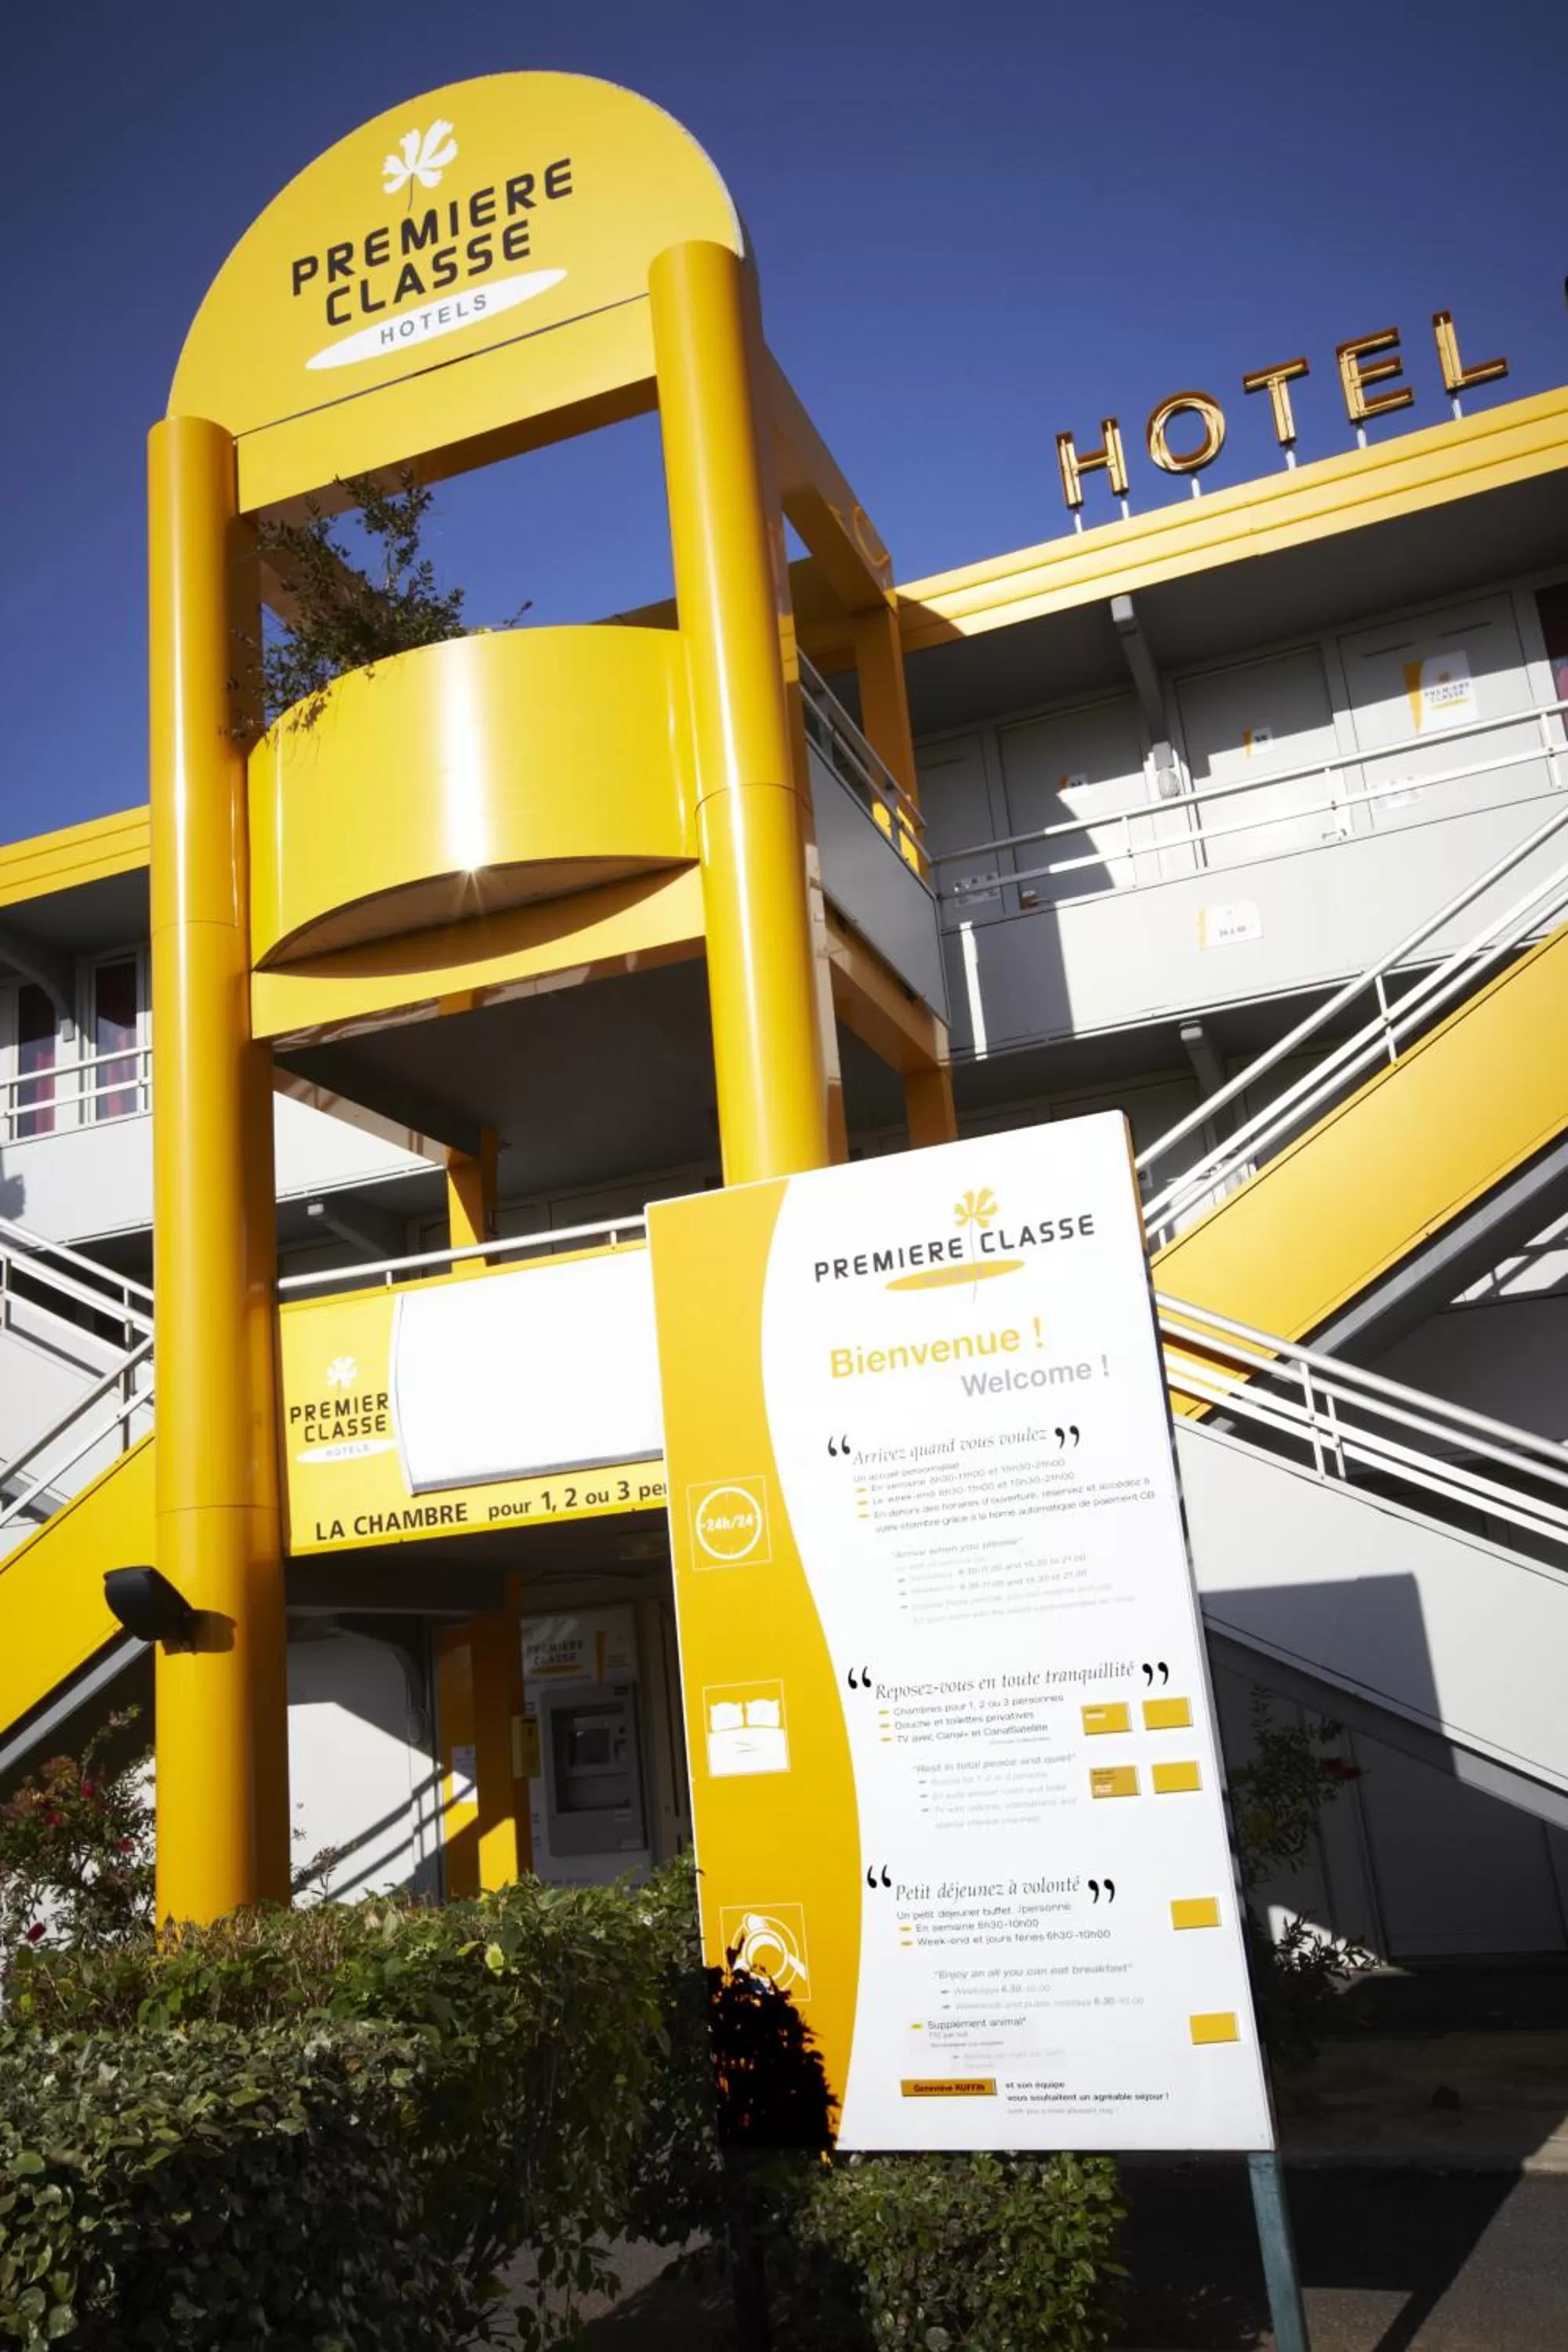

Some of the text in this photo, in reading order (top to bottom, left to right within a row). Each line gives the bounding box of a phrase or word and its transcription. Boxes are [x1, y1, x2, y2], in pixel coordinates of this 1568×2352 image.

[292, 158, 573, 297] PREMIERE
[325, 219, 530, 327] CLASSE
[380, 293, 488, 345] HOTELS
[1055, 309, 1509, 510] HOTEL
[815, 1213, 1095, 1283] PREMIERE CLASSE
[829, 1327, 1021, 1379] Bienvenue
[960, 1361, 1092, 1397] Welcome
[304, 1414, 387, 1443] CLASSE
[851, 1425, 1048, 1466] Arrivez quand vous voulez
[316, 1520, 346, 1541] LA
[354, 1502, 468, 1536] CHAMBRE
[488, 1501, 532, 1521] pour
[541, 1491, 556, 1512] 1,
[564, 1487, 577, 1508] 2
[585, 1490, 609, 1504] ou
[617, 1481, 630, 1501] 3
[875, 1658, 1137, 1703] Reposez-vous en toute tranquillité
[944, 1703, 967, 1713] pour
[987, 1699, 1001, 1708] ou
[1011, 1693, 1065, 1706] personnes
[894, 1719, 931, 1730] Douche
[933, 1717, 944, 1726] et
[985, 1710, 1035, 1723] privatives
[896, 1734, 909, 1744] TV
[911, 1733, 935, 1743] avec
[971, 1728, 982, 1737] et
[894, 1874, 1082, 1903] Petit déjeunez à volonté
[896, 1911, 910, 1920] Un
[912, 1909, 935, 1920] petit
[982, 1905, 1011, 1916] buffet
[914, 1923, 929, 1933] En
[931, 1921, 975, 1932] semaine
[971, 1935, 983, 1944] et
[985, 1934, 1012, 1944] jours
[1002, 1968, 1024, 1978] you
[1025, 1967, 1047, 1976] can
[1049, 1966, 1069, 1975] eat
[1029, 2092, 1077, 2102] souhaitent
